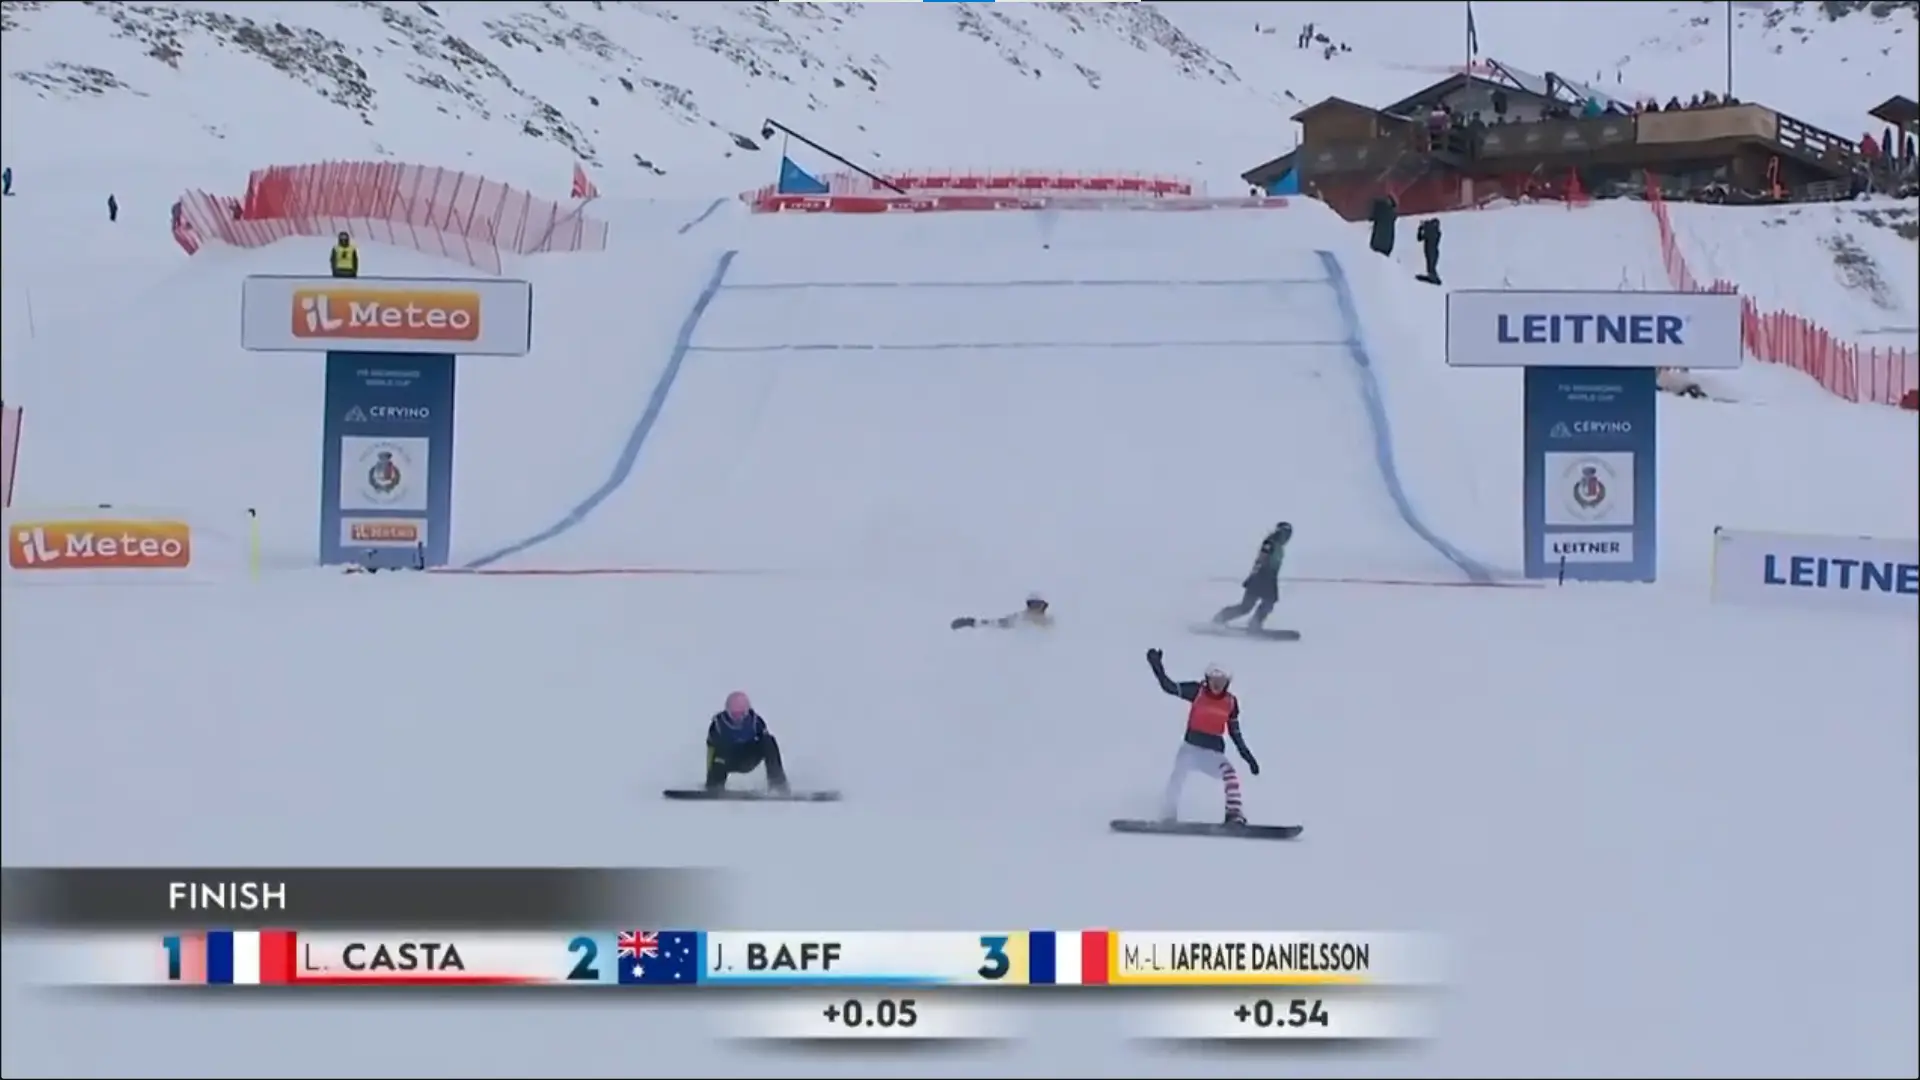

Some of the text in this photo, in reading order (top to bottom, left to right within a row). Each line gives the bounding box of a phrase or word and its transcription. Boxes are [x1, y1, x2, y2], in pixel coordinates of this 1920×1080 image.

[348, 301, 471, 329] Meteo
[1497, 314, 1684, 345] LEITNER
[369, 405, 430, 418] CERVINO
[1573, 421, 1632, 432] CERVINO
[65, 531, 182, 557] Meteo
[1553, 541, 1620, 554] LEITNER
[1764, 554, 1918, 594] LEITNE
